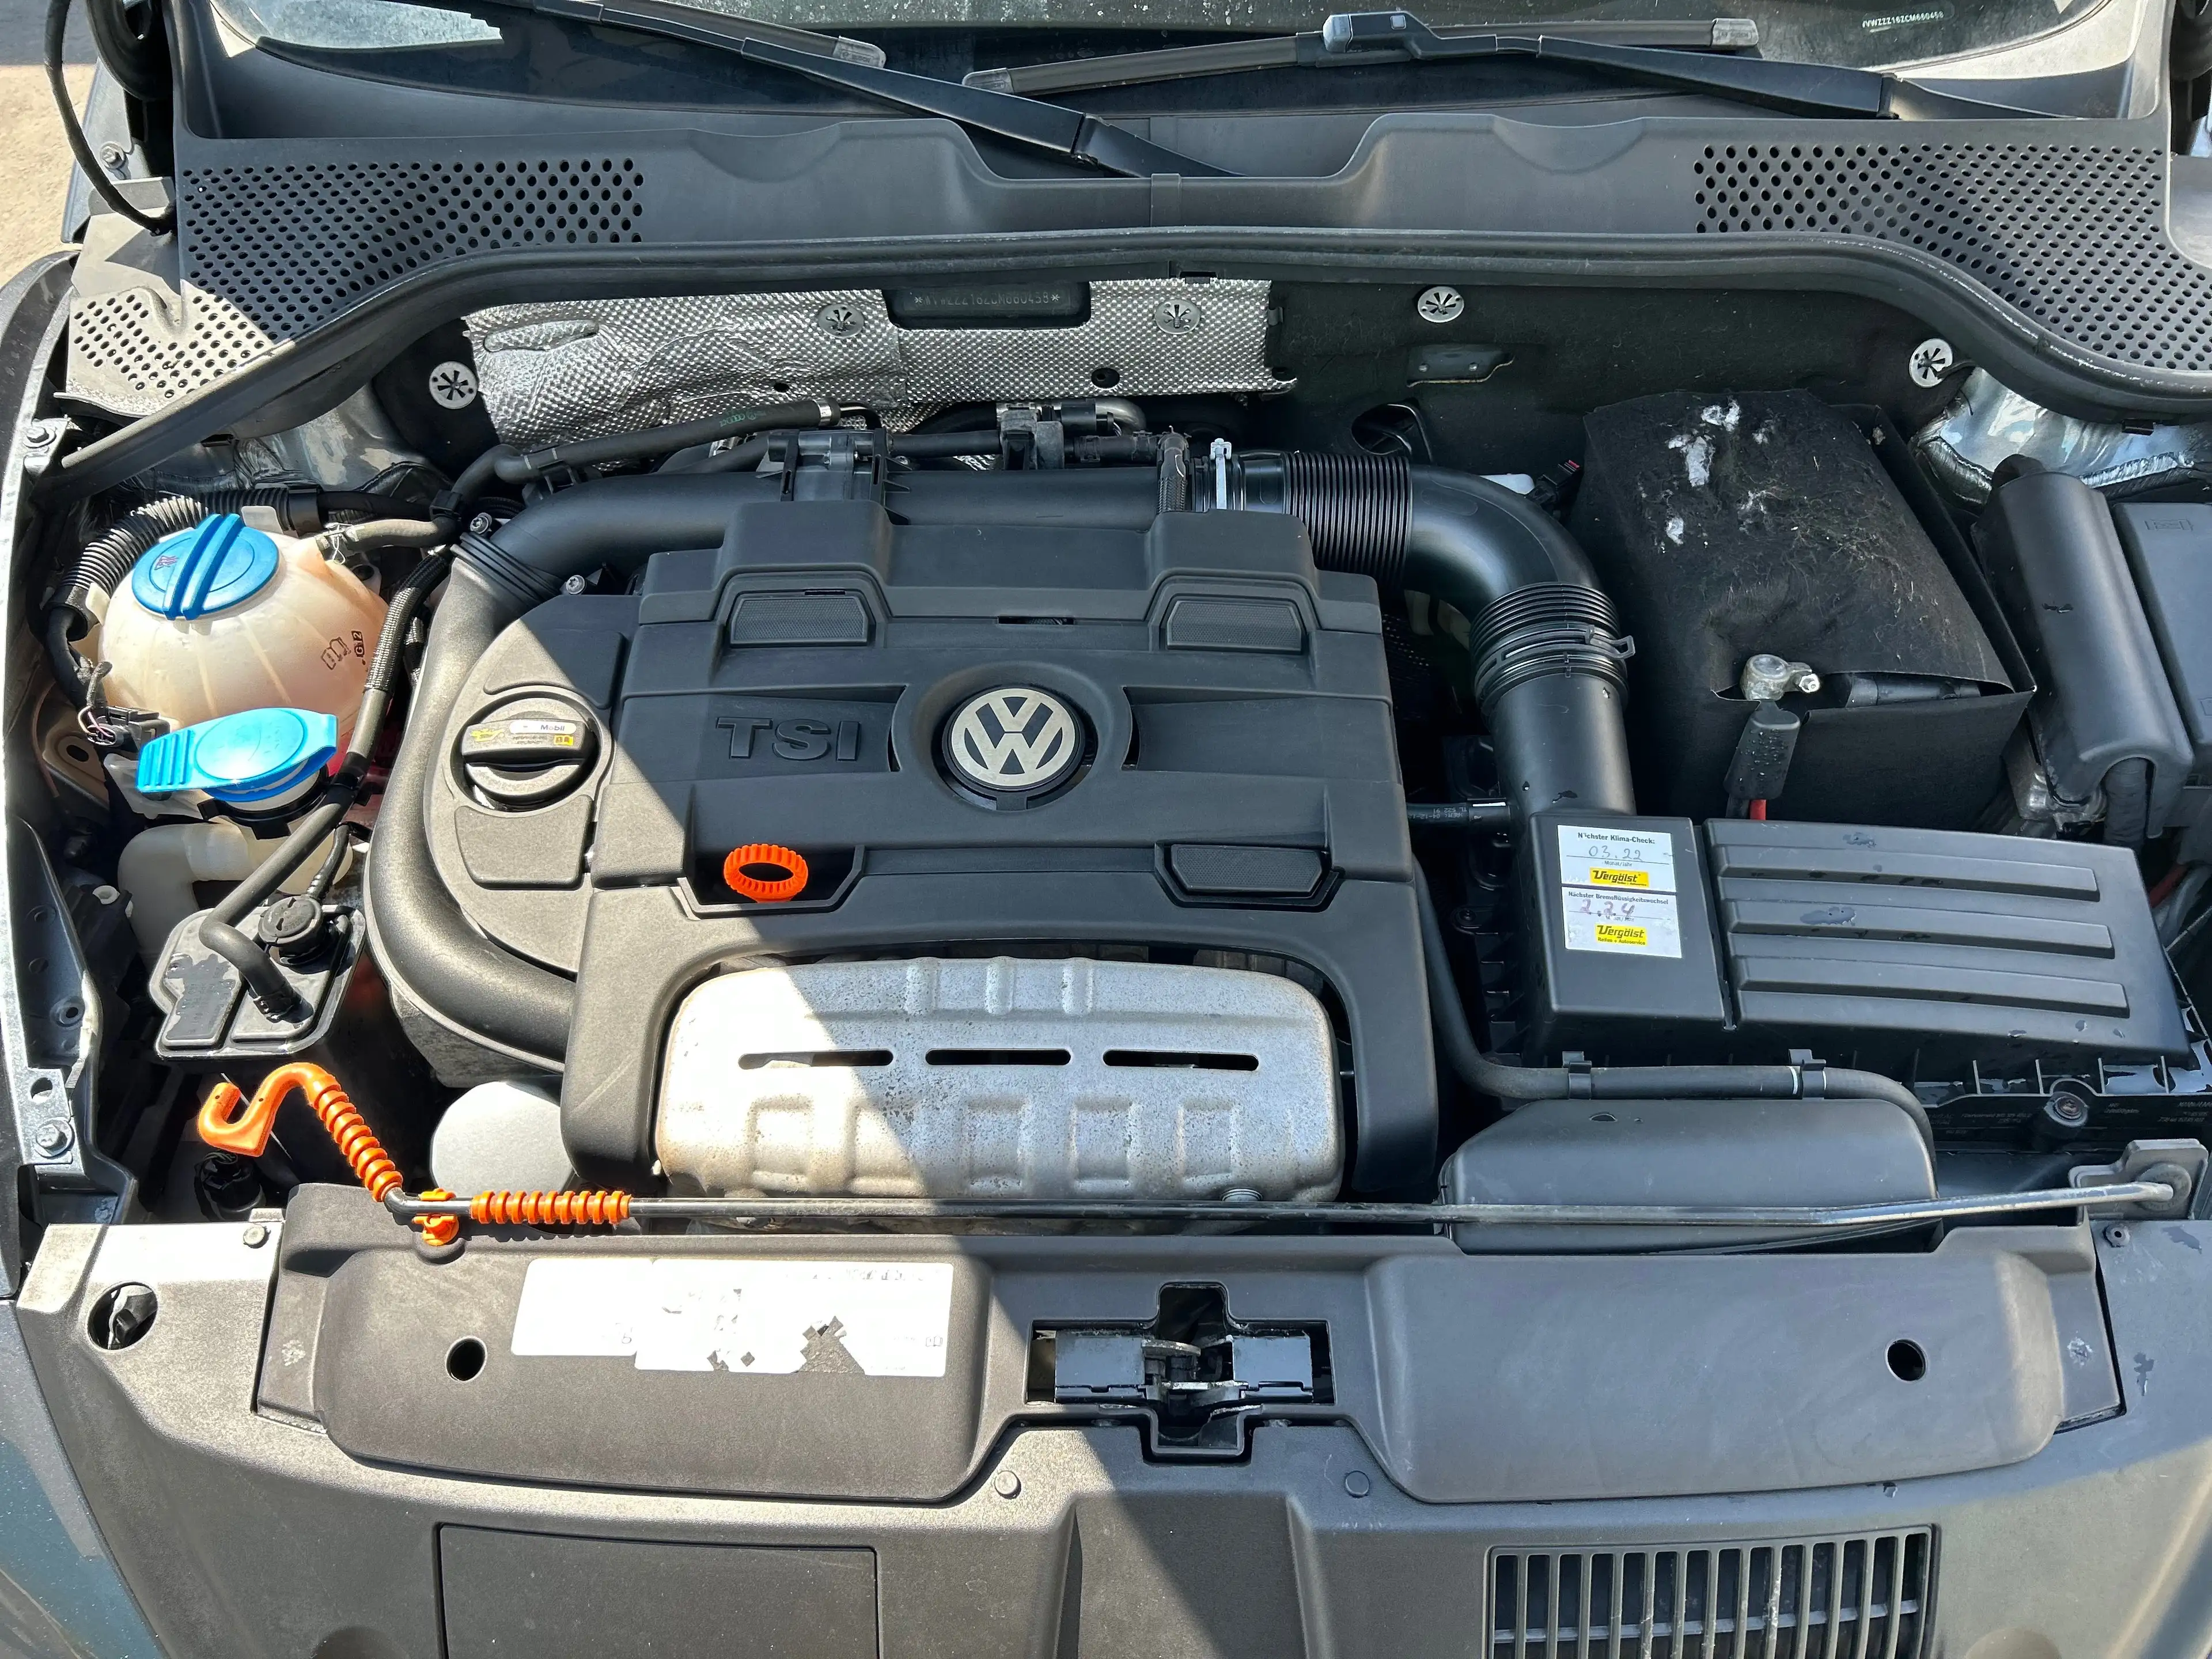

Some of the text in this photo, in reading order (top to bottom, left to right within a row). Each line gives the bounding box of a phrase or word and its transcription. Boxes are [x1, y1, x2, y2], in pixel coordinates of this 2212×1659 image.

[717, 716, 862, 762] TSI
[1593, 870, 1638, 883] Vergölst
[1597, 925, 1645, 938] Vergölst
